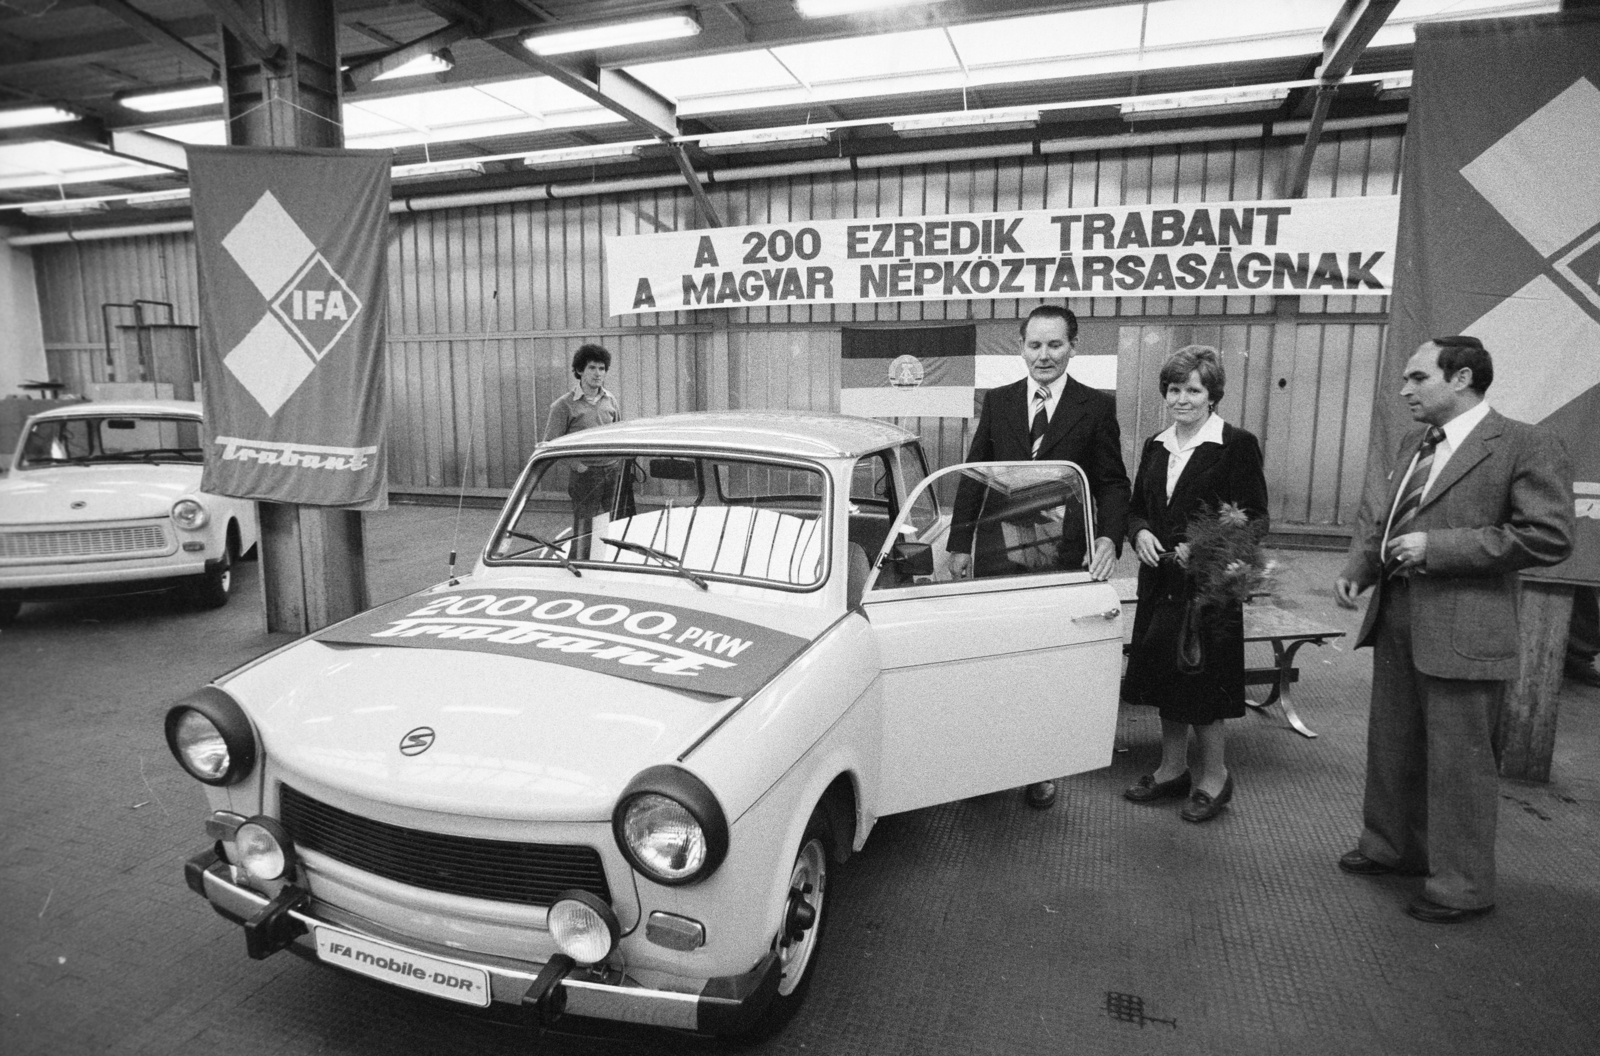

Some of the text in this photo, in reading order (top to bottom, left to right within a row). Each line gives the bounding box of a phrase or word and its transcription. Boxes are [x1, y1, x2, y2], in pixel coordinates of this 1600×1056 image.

[694, 206, 1292, 268] A 200 EZREDIK TRABANT
[632, 246, 1386, 310] A MAGYAR NÉPKÖZTÁRSASÁGNAK
[292, 290, 349, 321] IFA
[215, 435, 378, 472] Trabant
[370, 617, 738, 677] Trabant
[675, 626, 754, 658] PKW
[329, 942, 352, 958] IFA
